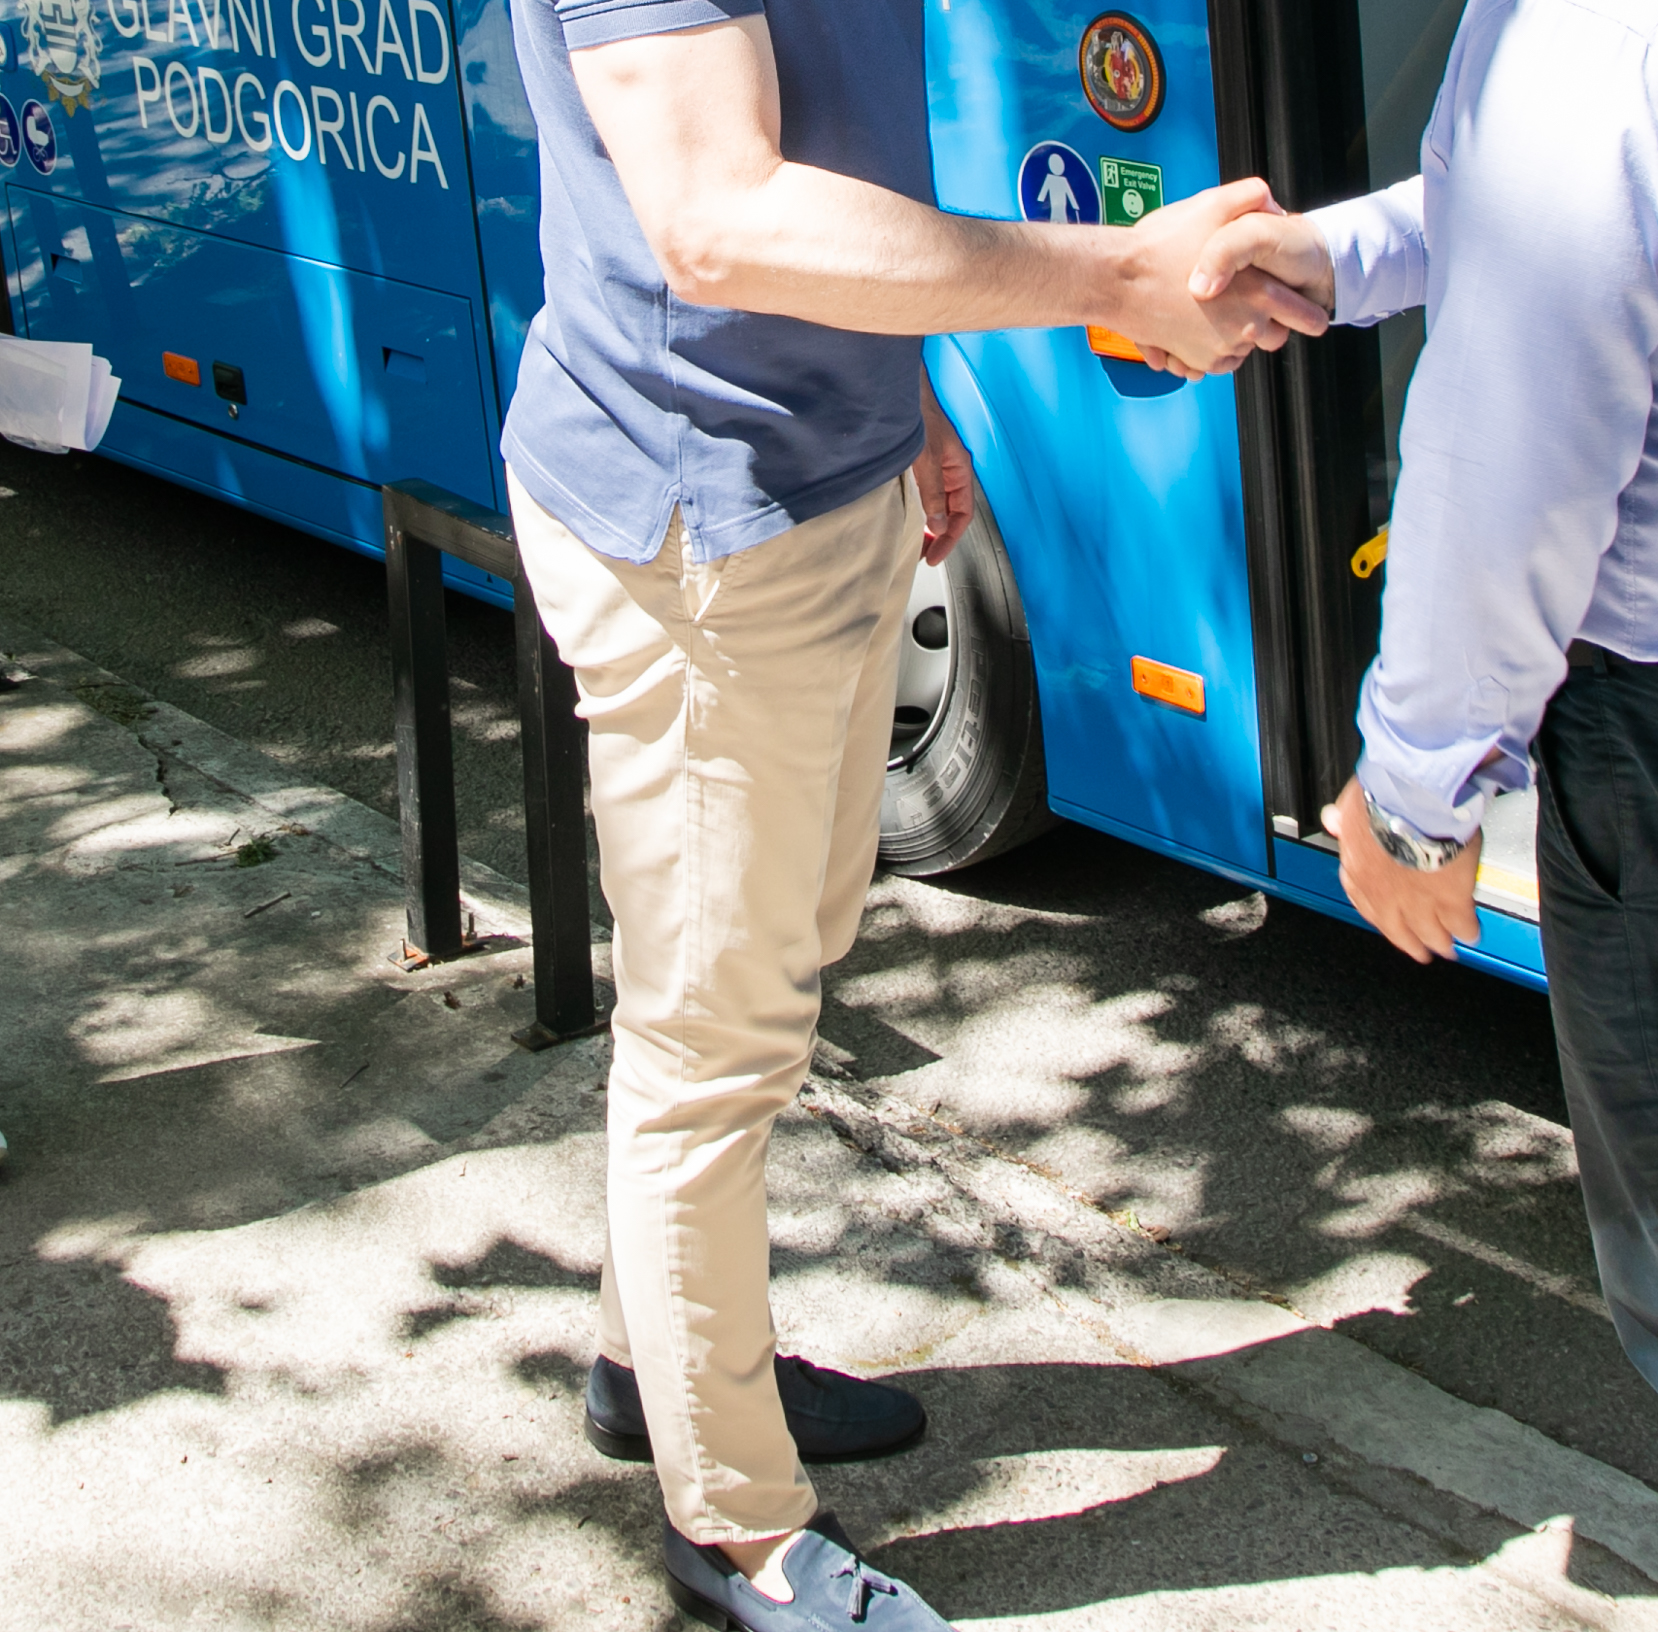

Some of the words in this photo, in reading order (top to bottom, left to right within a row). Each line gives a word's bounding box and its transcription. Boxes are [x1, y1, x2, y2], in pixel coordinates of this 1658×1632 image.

[134, 56, 450, 190] PODGORICA
[1120, 167, 1158, 182] Emergency
[1123, 177, 1137, 188] Exit
[1137, 180, 1157, 192] Valve
